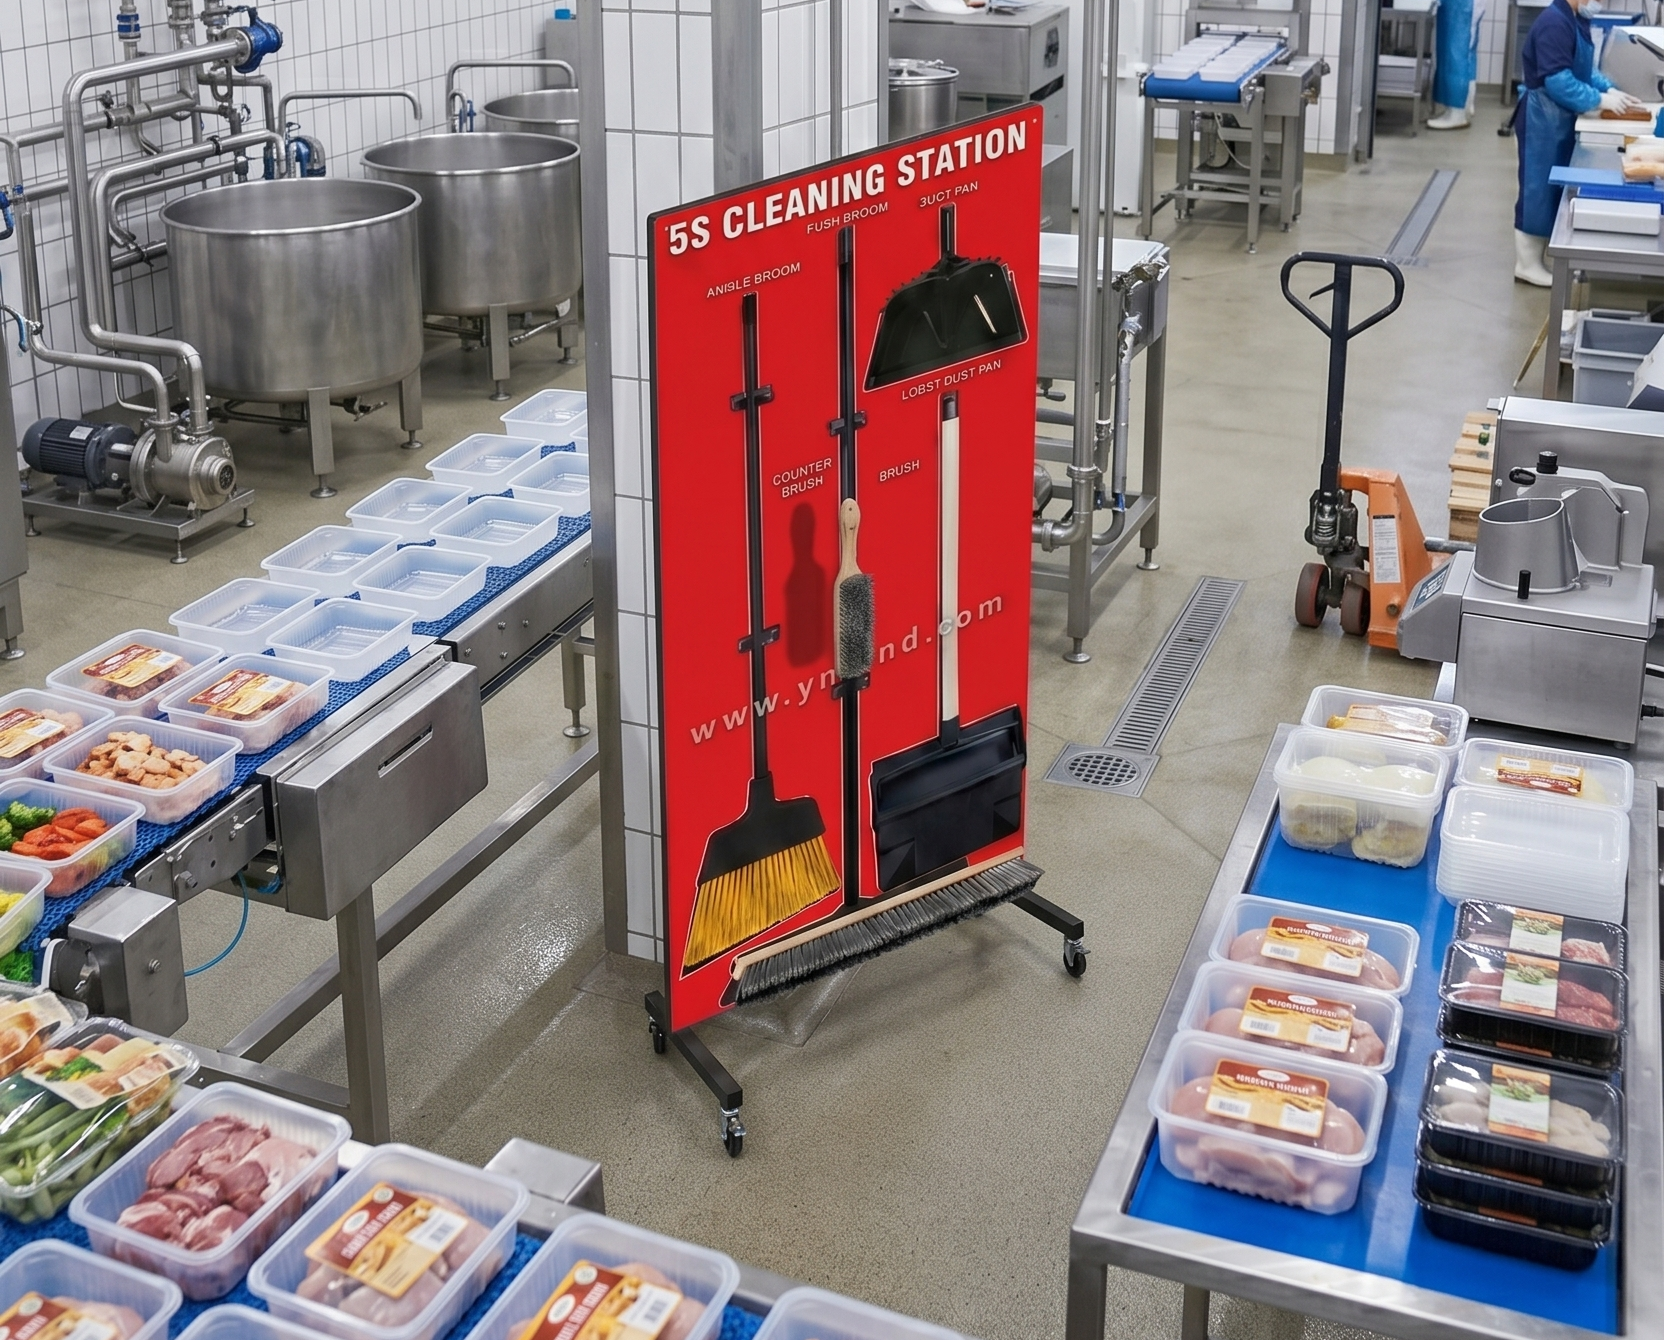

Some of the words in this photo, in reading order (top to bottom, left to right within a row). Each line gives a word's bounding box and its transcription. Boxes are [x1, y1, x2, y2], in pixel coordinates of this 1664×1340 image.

[669, 215, 711, 255] 5S
[722, 163, 886, 239] CLEANING
[896, 120, 1027, 188] STATION
[954, 180, 978, 196] PAN
[806, 215, 840, 235] FUSH
[843, 201, 889, 224] BROOM
[754, 261, 801, 285] BROOM
[901, 378, 941, 401] LOBST
[943, 367, 976, 387] DUST
[978, 359, 1001, 375] PAN
[772, 457, 832, 487] COUNTER
[879, 459, 920, 483] BRUSH
[781, 475, 823, 499] BRUSH
